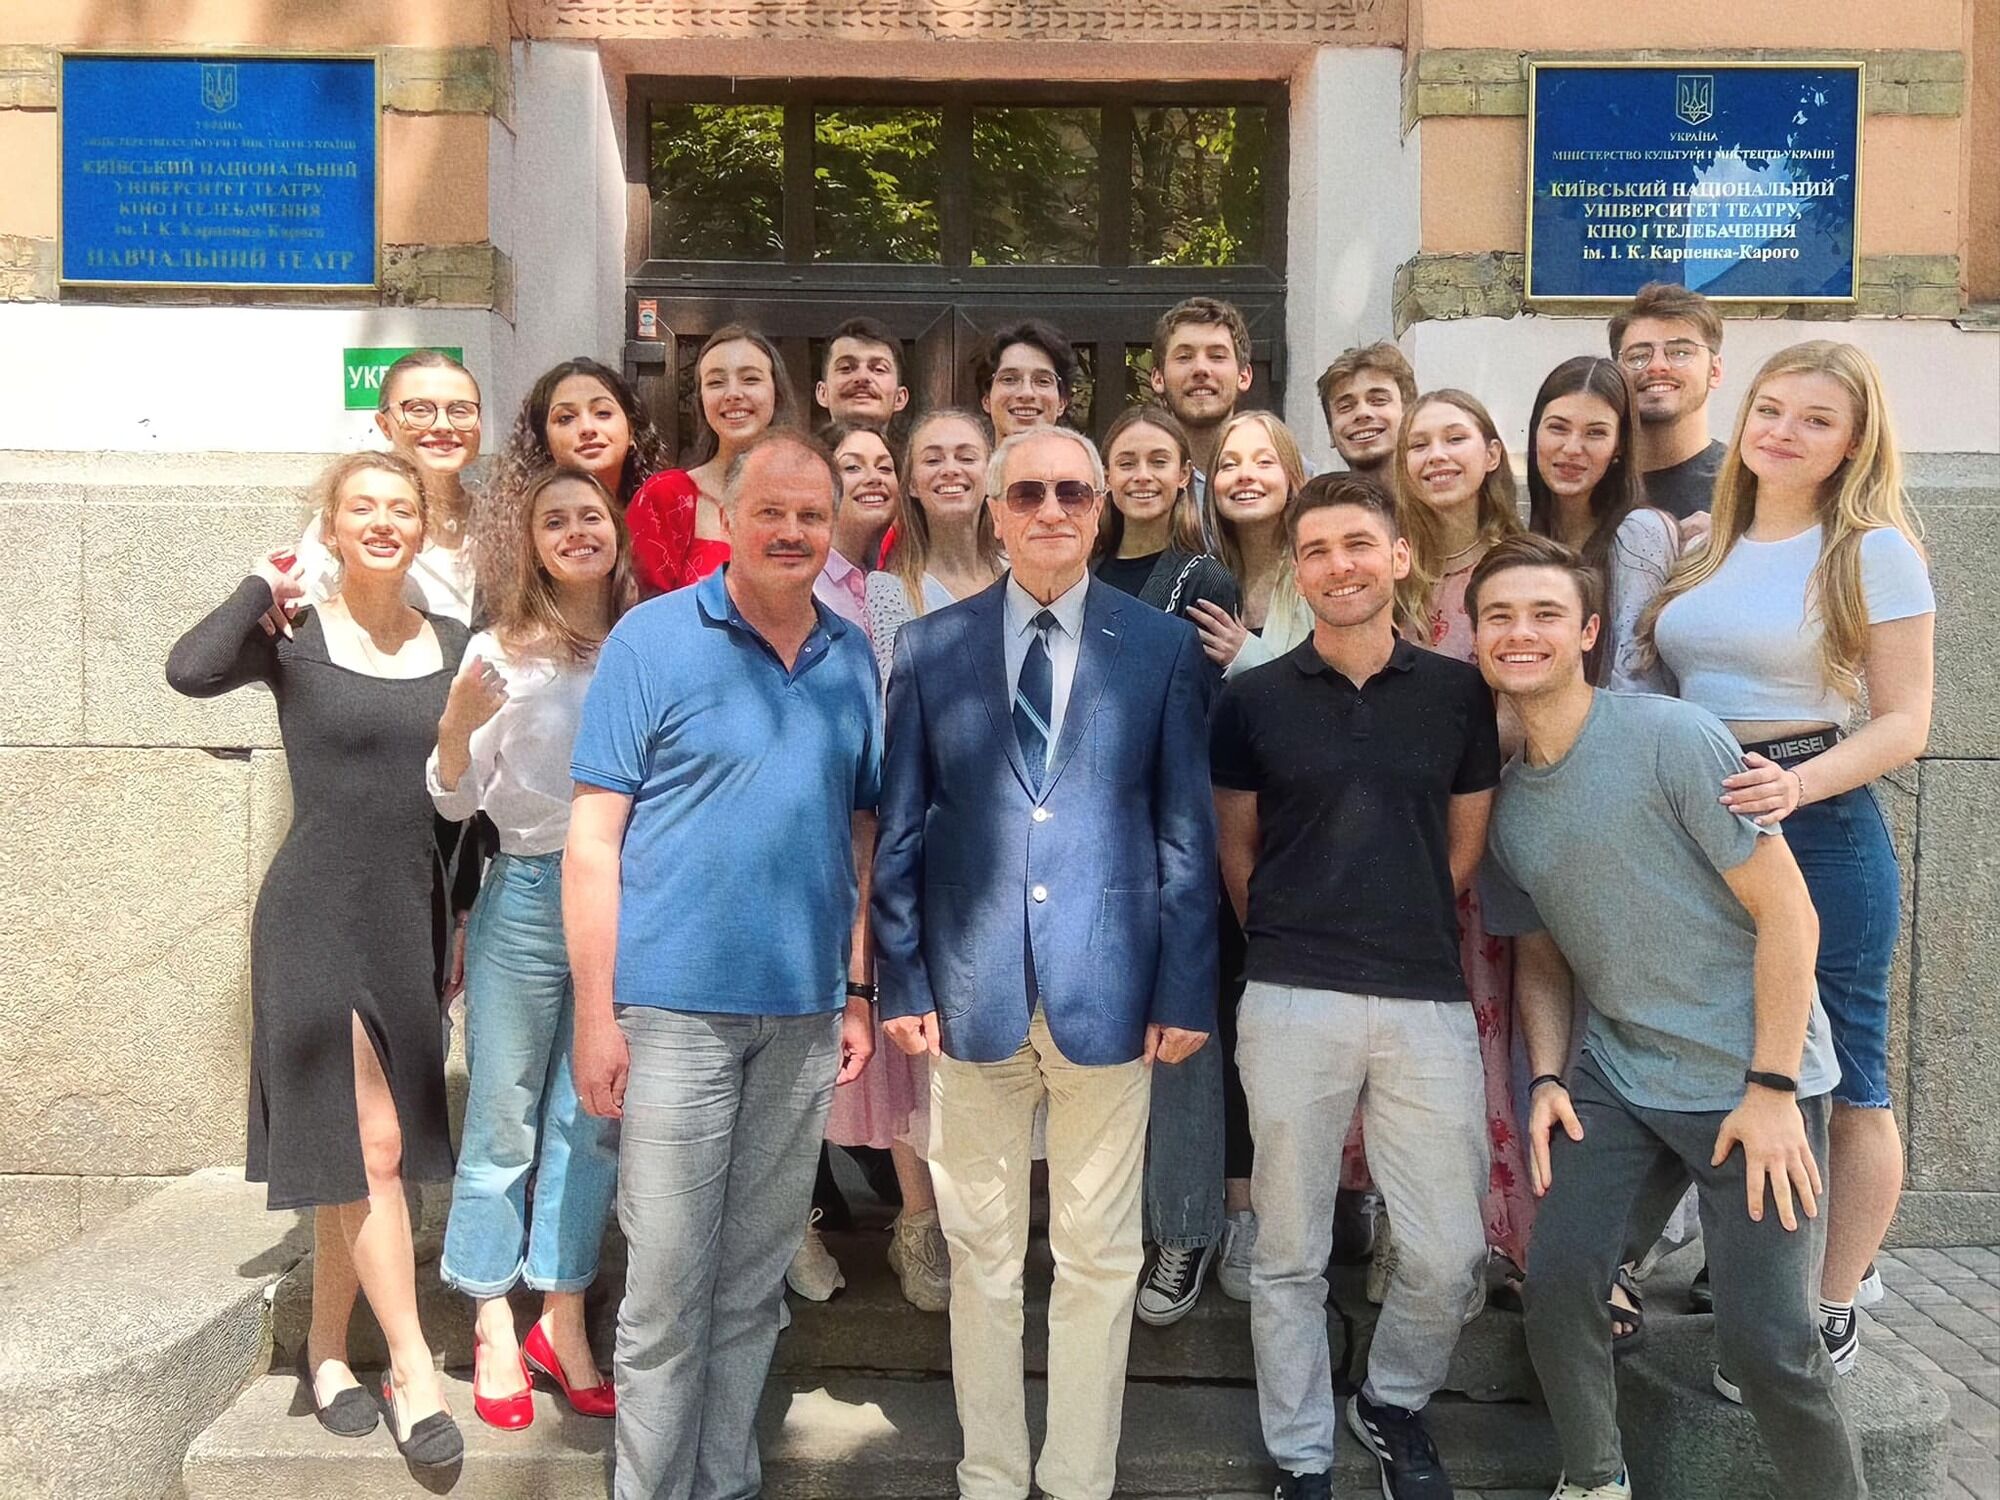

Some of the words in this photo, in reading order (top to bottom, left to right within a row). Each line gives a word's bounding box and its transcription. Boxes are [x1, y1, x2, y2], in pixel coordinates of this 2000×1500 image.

[1670, 129, 1718, 141] УКРАЇНА
[1552, 150, 1642, 160] МІНІСТЕРСТВО
[1644, 150, 1704, 160] КУЛЬТУРИ
[1782, 148, 1834, 160] УКРАЇНИ
[200, 160, 358, 179] НАЦІОНАЛЬНИЙ
[1551, 180, 1667, 197] КИЇВСЬКИЙ
[1672, 179, 1835, 199] НАЦІОНАЛЬНИЙ
[1583, 203, 1720, 218] УНІВЕРСИТЕТ
[1725, 202, 1802, 221] ТЕАТРУ,
[1587, 223, 1637, 238] КІНО
[1642, 223, 1649, 238] І
[1653, 222, 1797, 238] ТЕЛЕБАЧЕННЯ
[1583, 245, 1606, 259] ім.
[1627, 244, 1646, 259] К.
[1650, 244, 1800, 263] Карпенка-Карого
[1768, 736, 1828, 760] DIESEL
